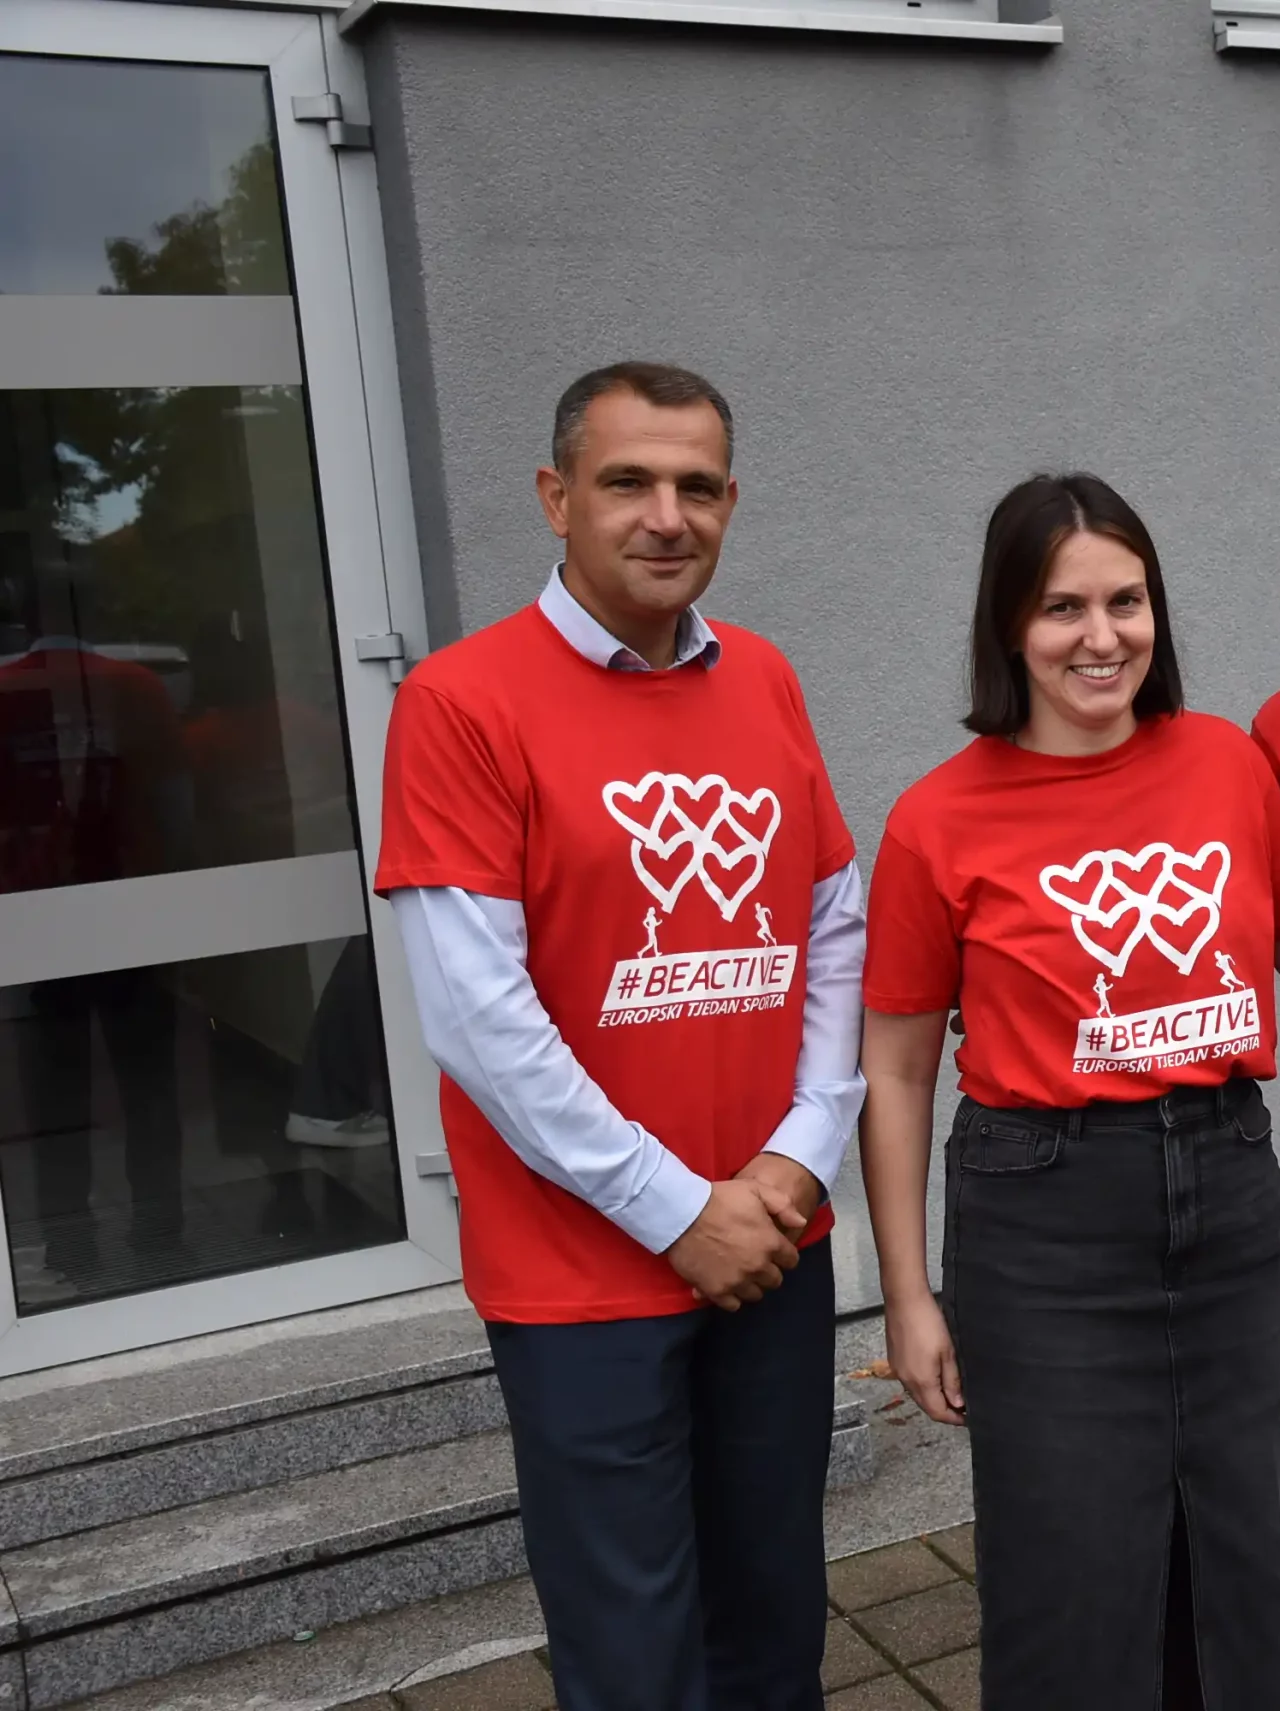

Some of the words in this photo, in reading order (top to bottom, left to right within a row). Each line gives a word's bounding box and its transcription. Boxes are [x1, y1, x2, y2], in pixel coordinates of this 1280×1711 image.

[617, 953, 790, 1000] #BEACTIVE
[597, 1003, 683, 1028] EUROPSKI
[688, 999, 739, 1017] TJEDAN
[741, 993, 786, 1012] SPORTA
[1085, 997, 1255, 1053] #BEACTIVE
[1072, 1056, 1153, 1074] EUROPSKI
[1155, 1046, 1209, 1070] TJEDAN
[1211, 1035, 1260, 1059] SPORTA
